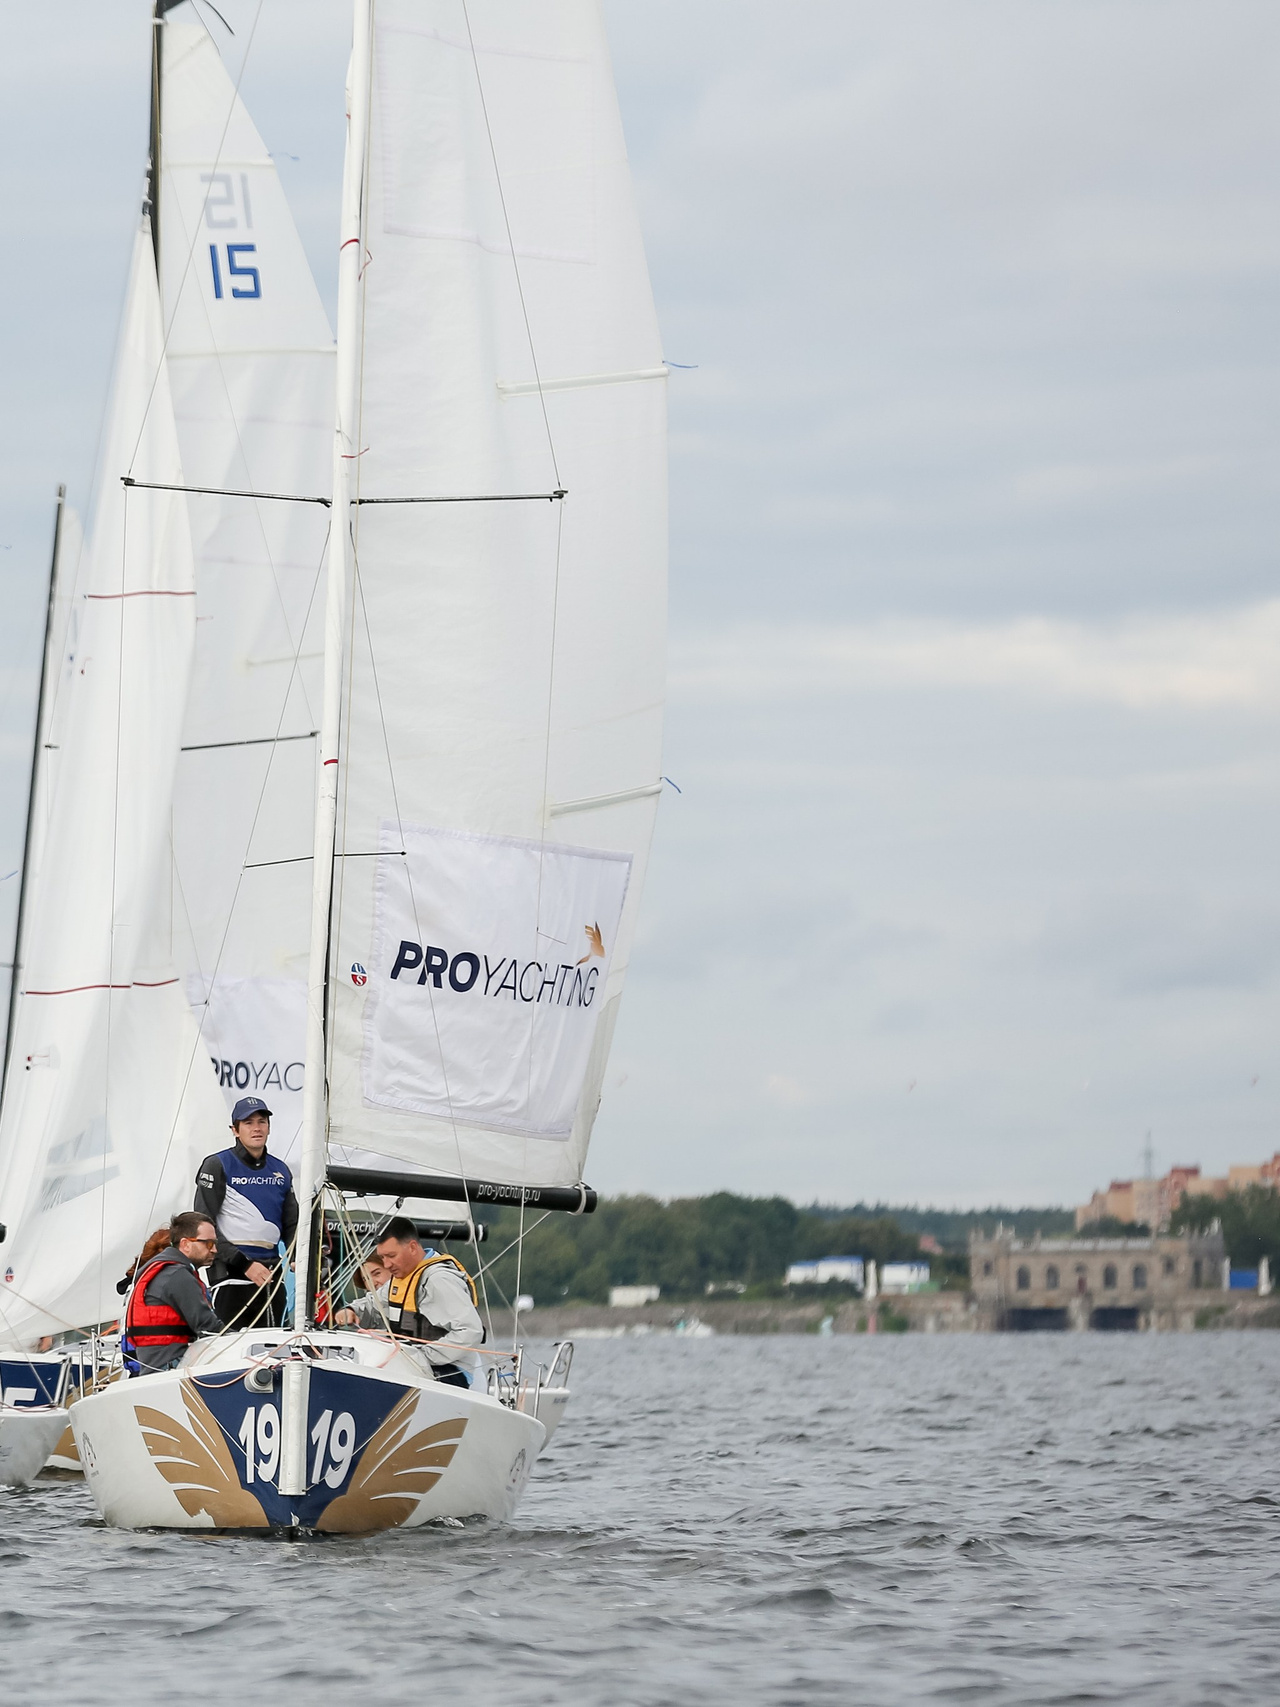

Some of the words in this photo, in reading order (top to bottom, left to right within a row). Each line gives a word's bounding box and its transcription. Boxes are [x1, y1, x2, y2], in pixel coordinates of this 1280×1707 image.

[208, 243, 262, 300] 15
[390, 939, 600, 1009] PROYACHTING
[476, 1182, 541, 1204] pro-yachting.ru
[237, 1402, 281, 1486] 19
[310, 1408, 356, 1489] 19
